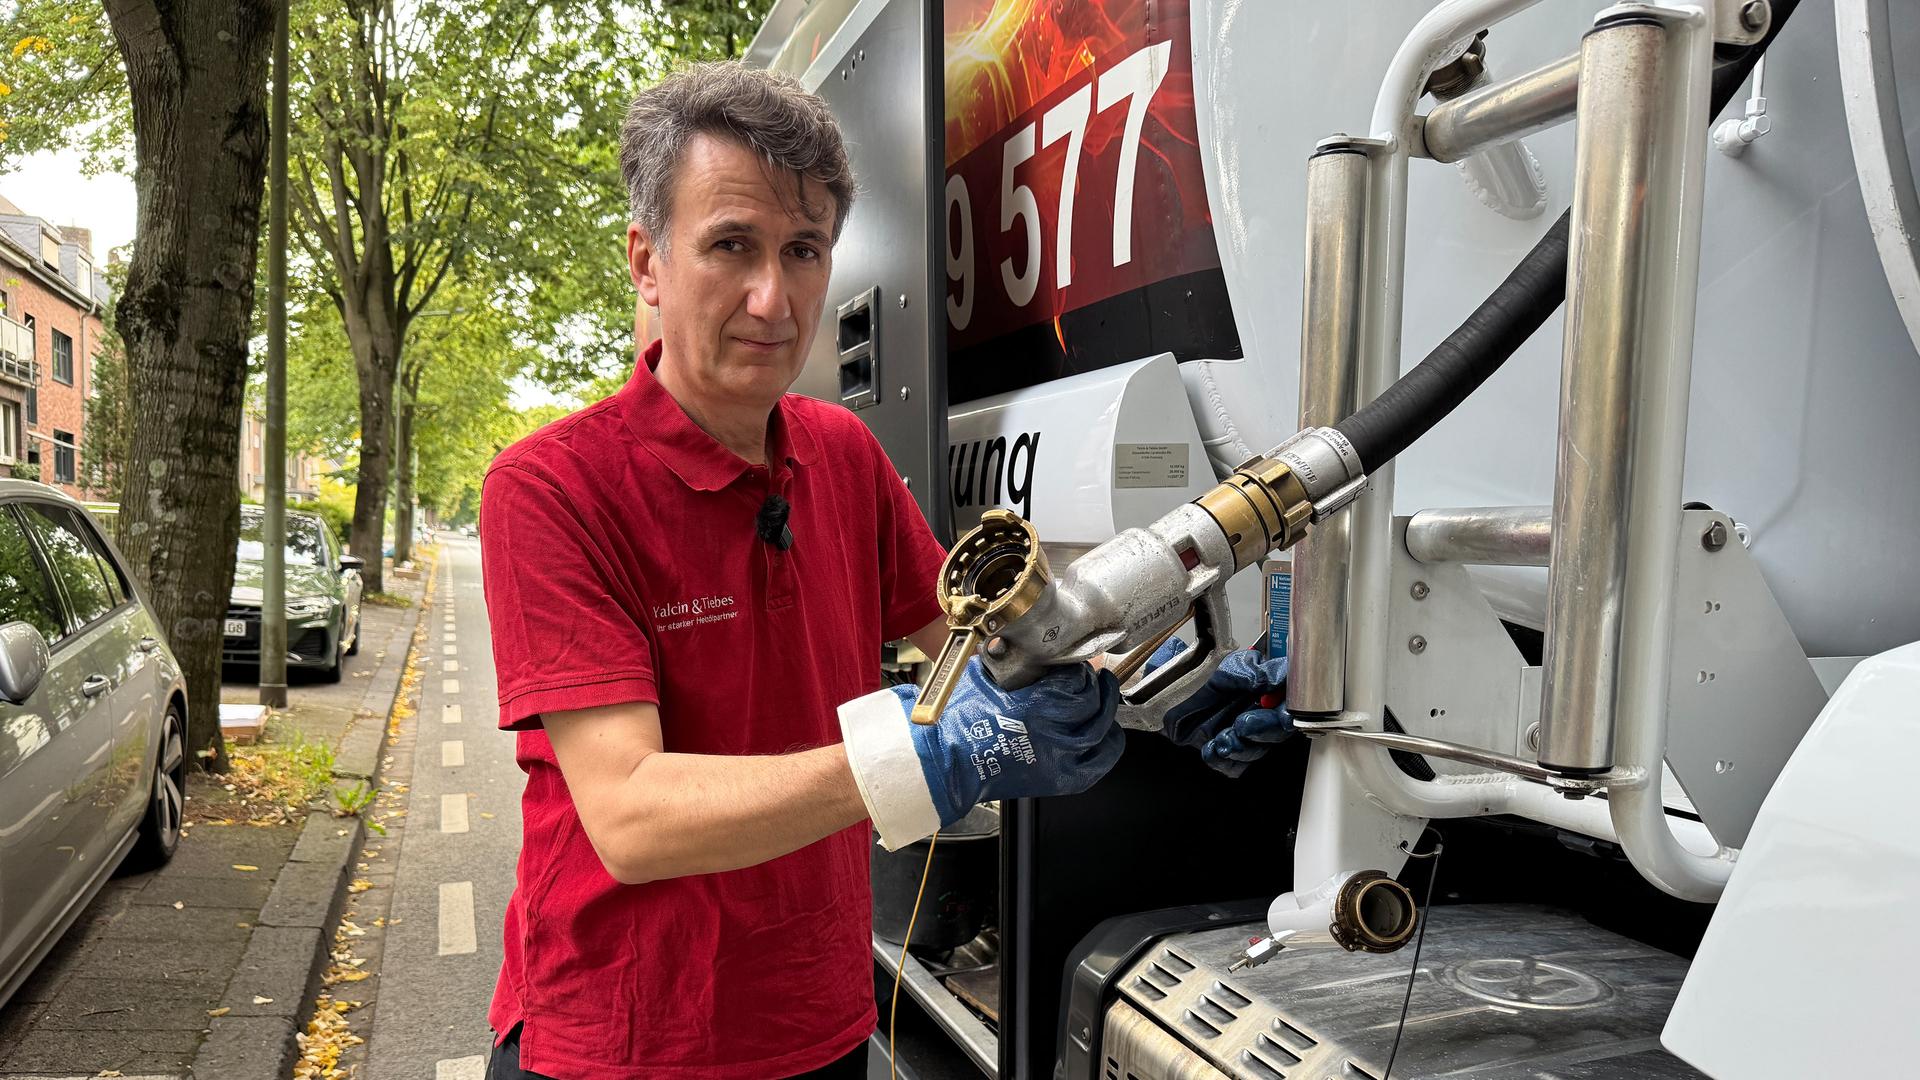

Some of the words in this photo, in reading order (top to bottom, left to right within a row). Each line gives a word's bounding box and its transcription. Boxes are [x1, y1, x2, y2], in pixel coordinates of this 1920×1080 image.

[1000, 39, 1172, 308] 577
[948, 431, 1041, 522] ung
[652, 602, 688, 618] Yalcin
[692, 598, 703, 615] &
[701, 595, 734, 610] Tiebes
[1133, 596, 1180, 631] ELAFLEX
[926, 649, 961, 702] ELAFLEX
[992, 742, 1001, 751] 10
[997, 733, 1011, 756] 03440
[1008, 737, 1025, 762] SAFETY
[1018, 734, 1037, 765] NITRAS
